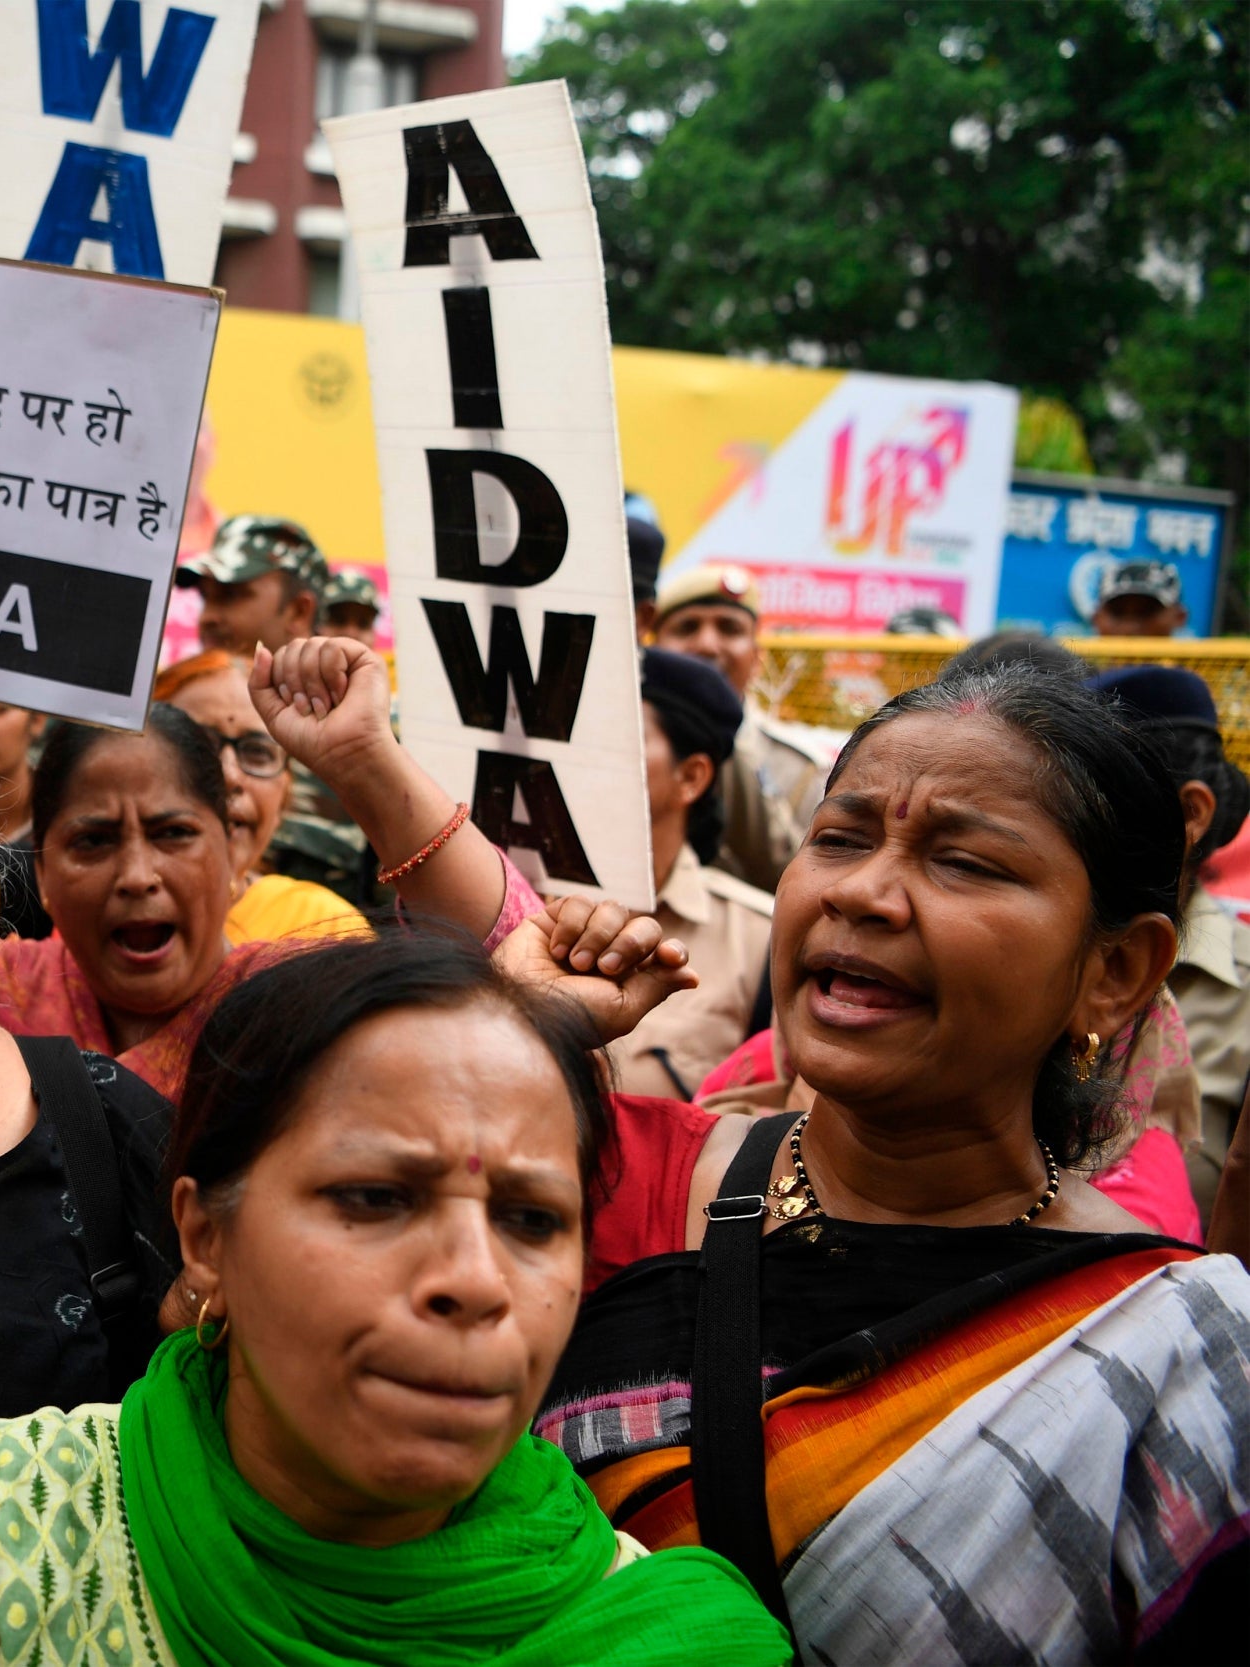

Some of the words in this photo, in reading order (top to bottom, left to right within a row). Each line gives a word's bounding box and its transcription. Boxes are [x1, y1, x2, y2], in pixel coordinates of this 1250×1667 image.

[20, 389, 73, 437] पर
[82, 387, 133, 448] हो
[44, 479, 126, 528] पात्र
[135, 480, 168, 542] है
[401, 119, 604, 889] AIDWA
